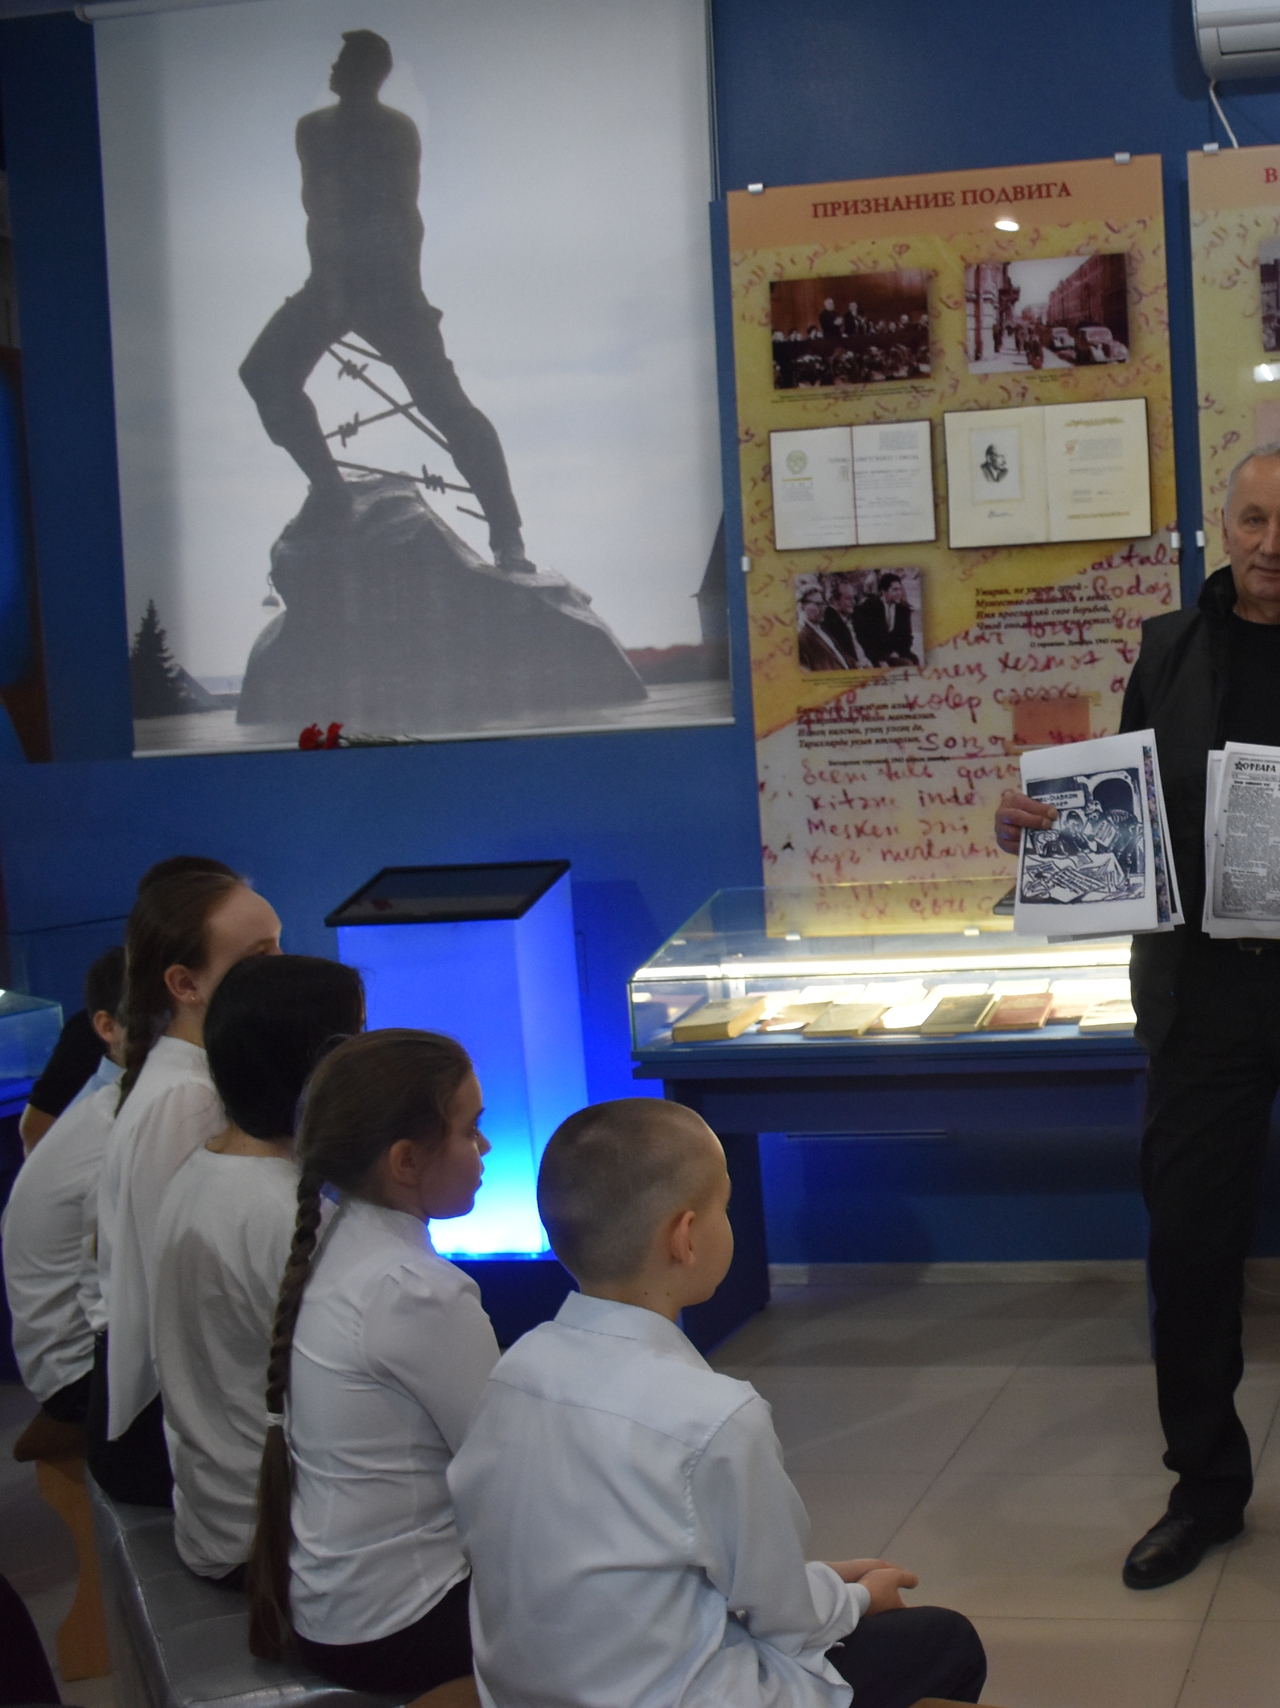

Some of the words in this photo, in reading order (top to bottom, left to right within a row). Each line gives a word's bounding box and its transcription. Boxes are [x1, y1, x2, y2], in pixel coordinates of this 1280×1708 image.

[1263, 167, 1279, 184] В
[811, 191, 956, 219] ПРИЗНАНИЕ
[960, 181, 1073, 206] ПОДВИГА
